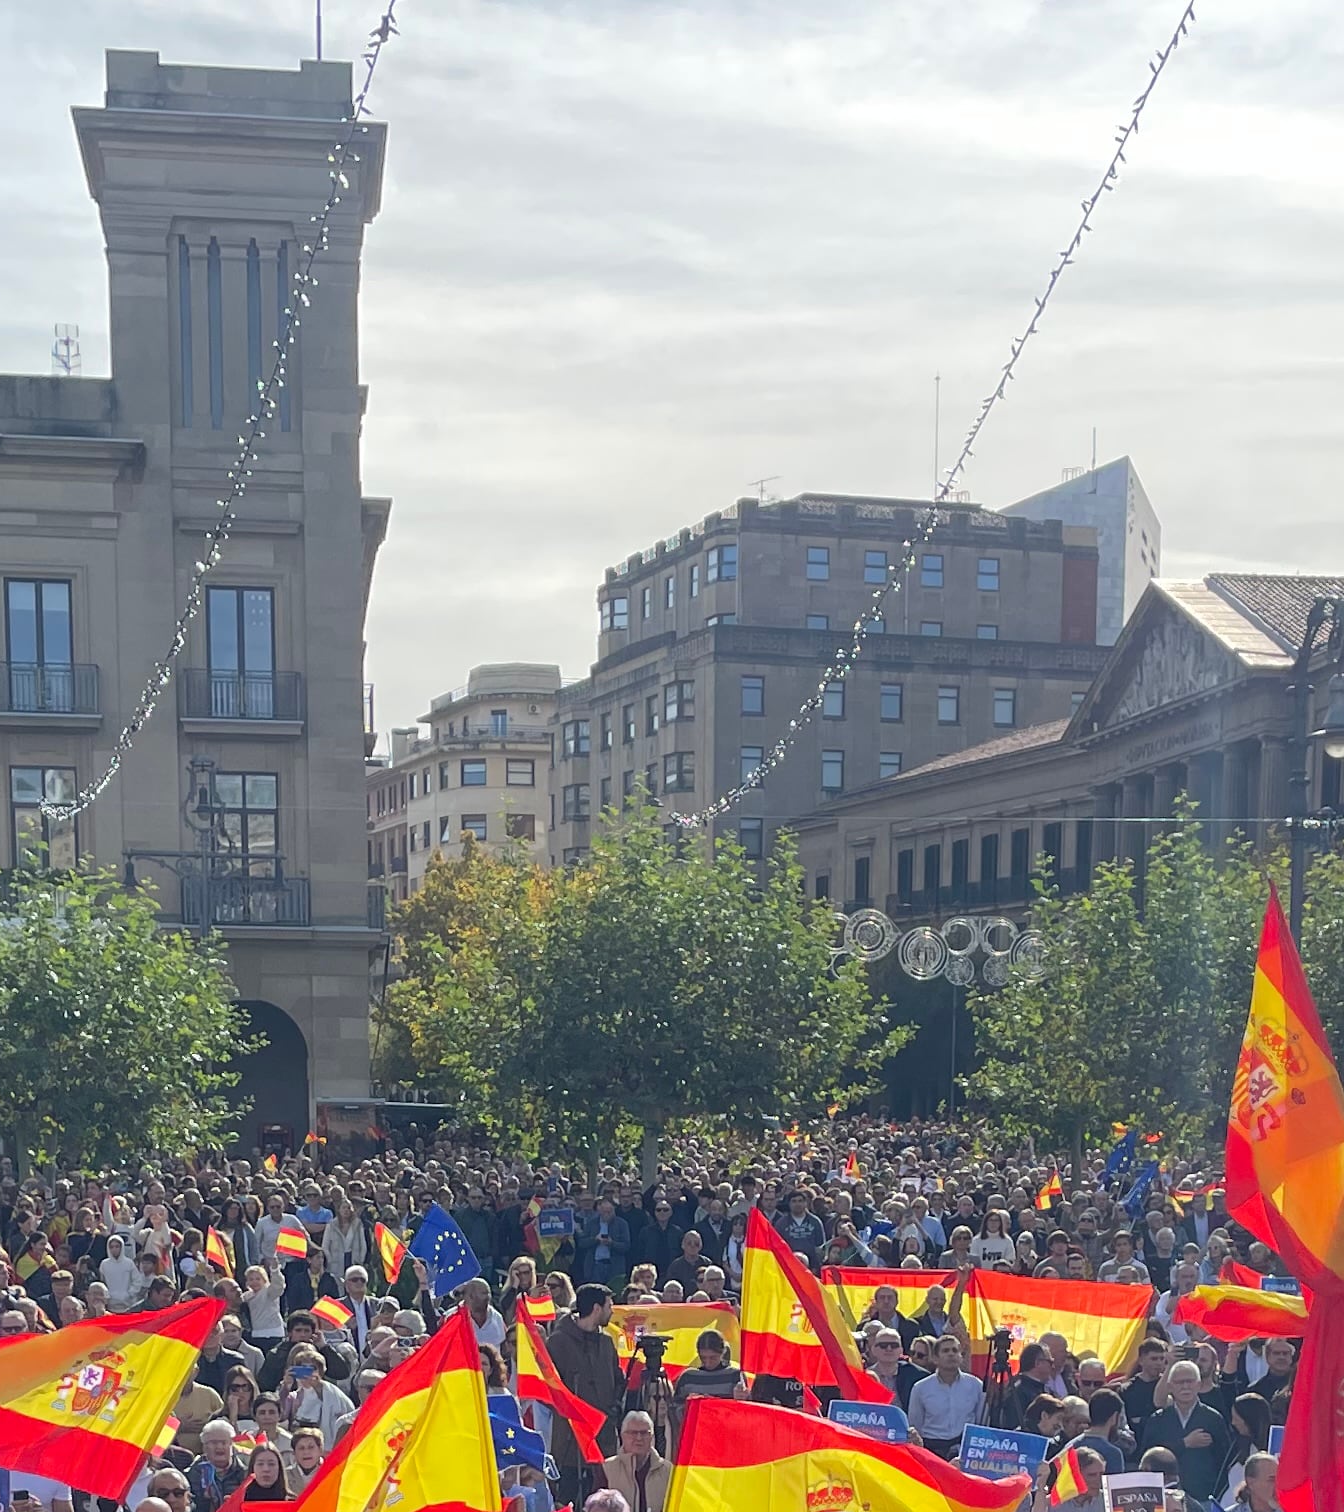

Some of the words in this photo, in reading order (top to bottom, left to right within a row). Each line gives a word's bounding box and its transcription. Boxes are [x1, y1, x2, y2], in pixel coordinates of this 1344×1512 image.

[835, 1410, 886, 1427] ESPAÑA
[969, 1436, 1019, 1452] ESPAÑA
[967, 1447, 985, 1459] EN
